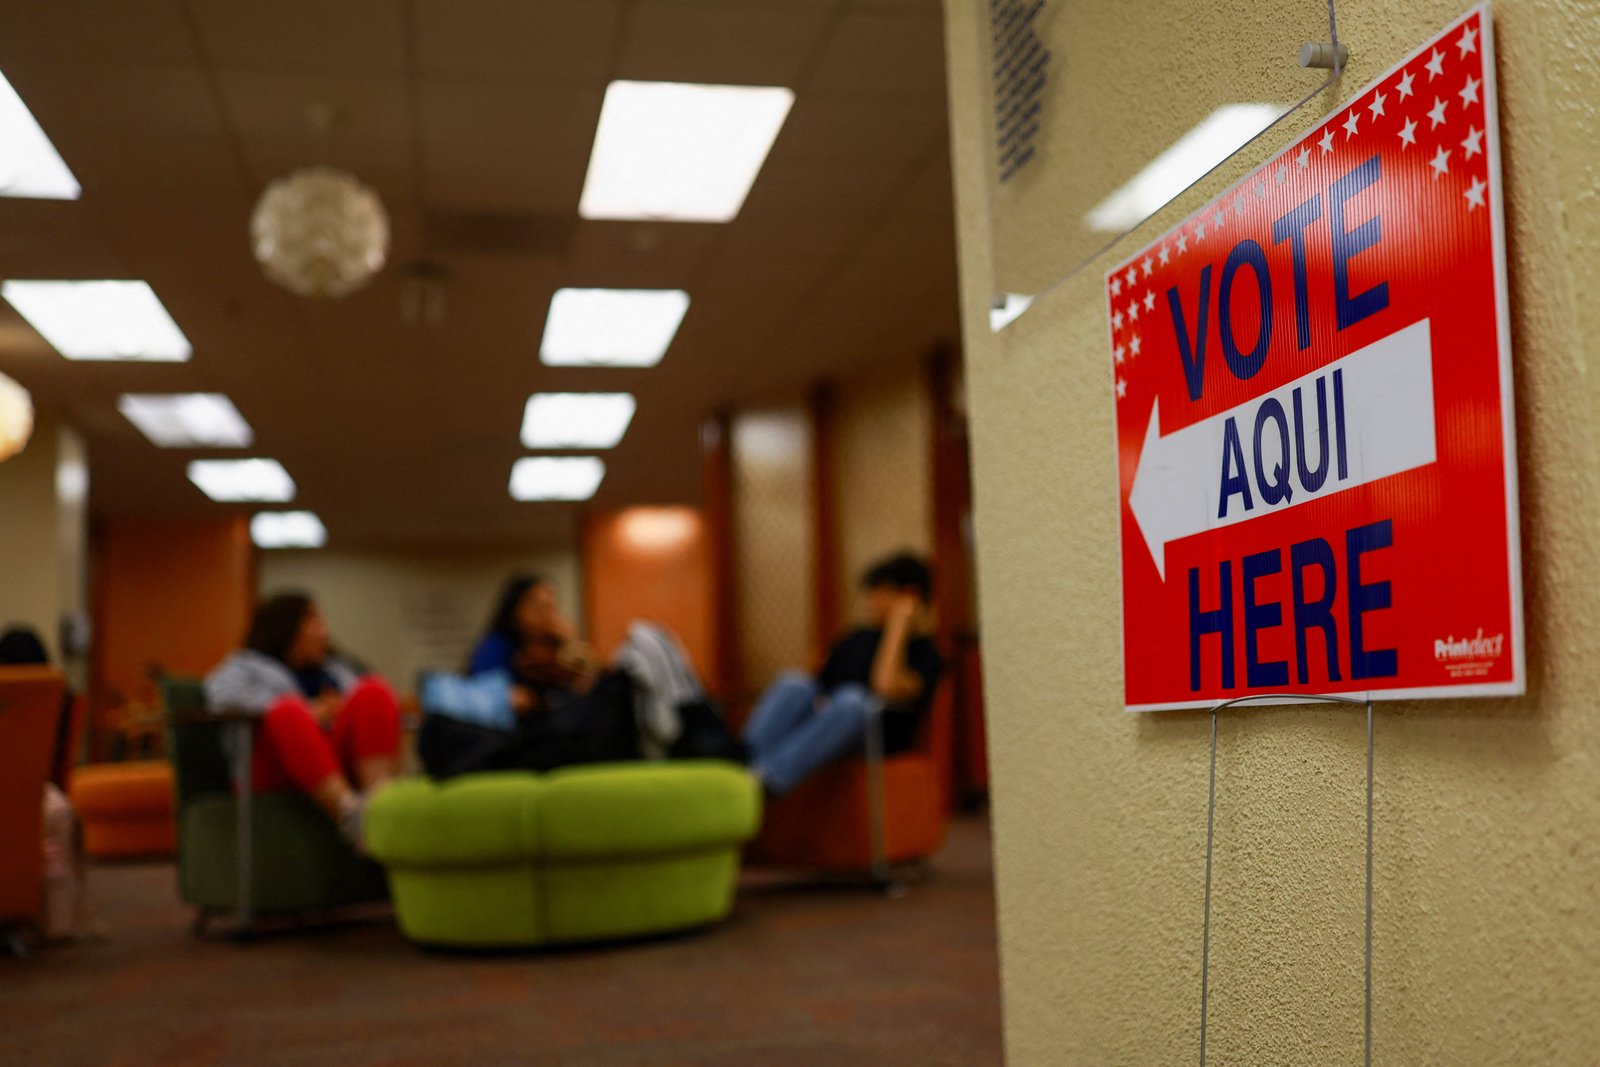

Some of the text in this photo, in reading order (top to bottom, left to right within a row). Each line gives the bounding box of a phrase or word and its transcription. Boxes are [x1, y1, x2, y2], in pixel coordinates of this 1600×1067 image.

[1167, 154, 1389, 402] VOTE
[1217, 367, 1348, 518] AQUI
[1188, 519, 1398, 691] HERE
